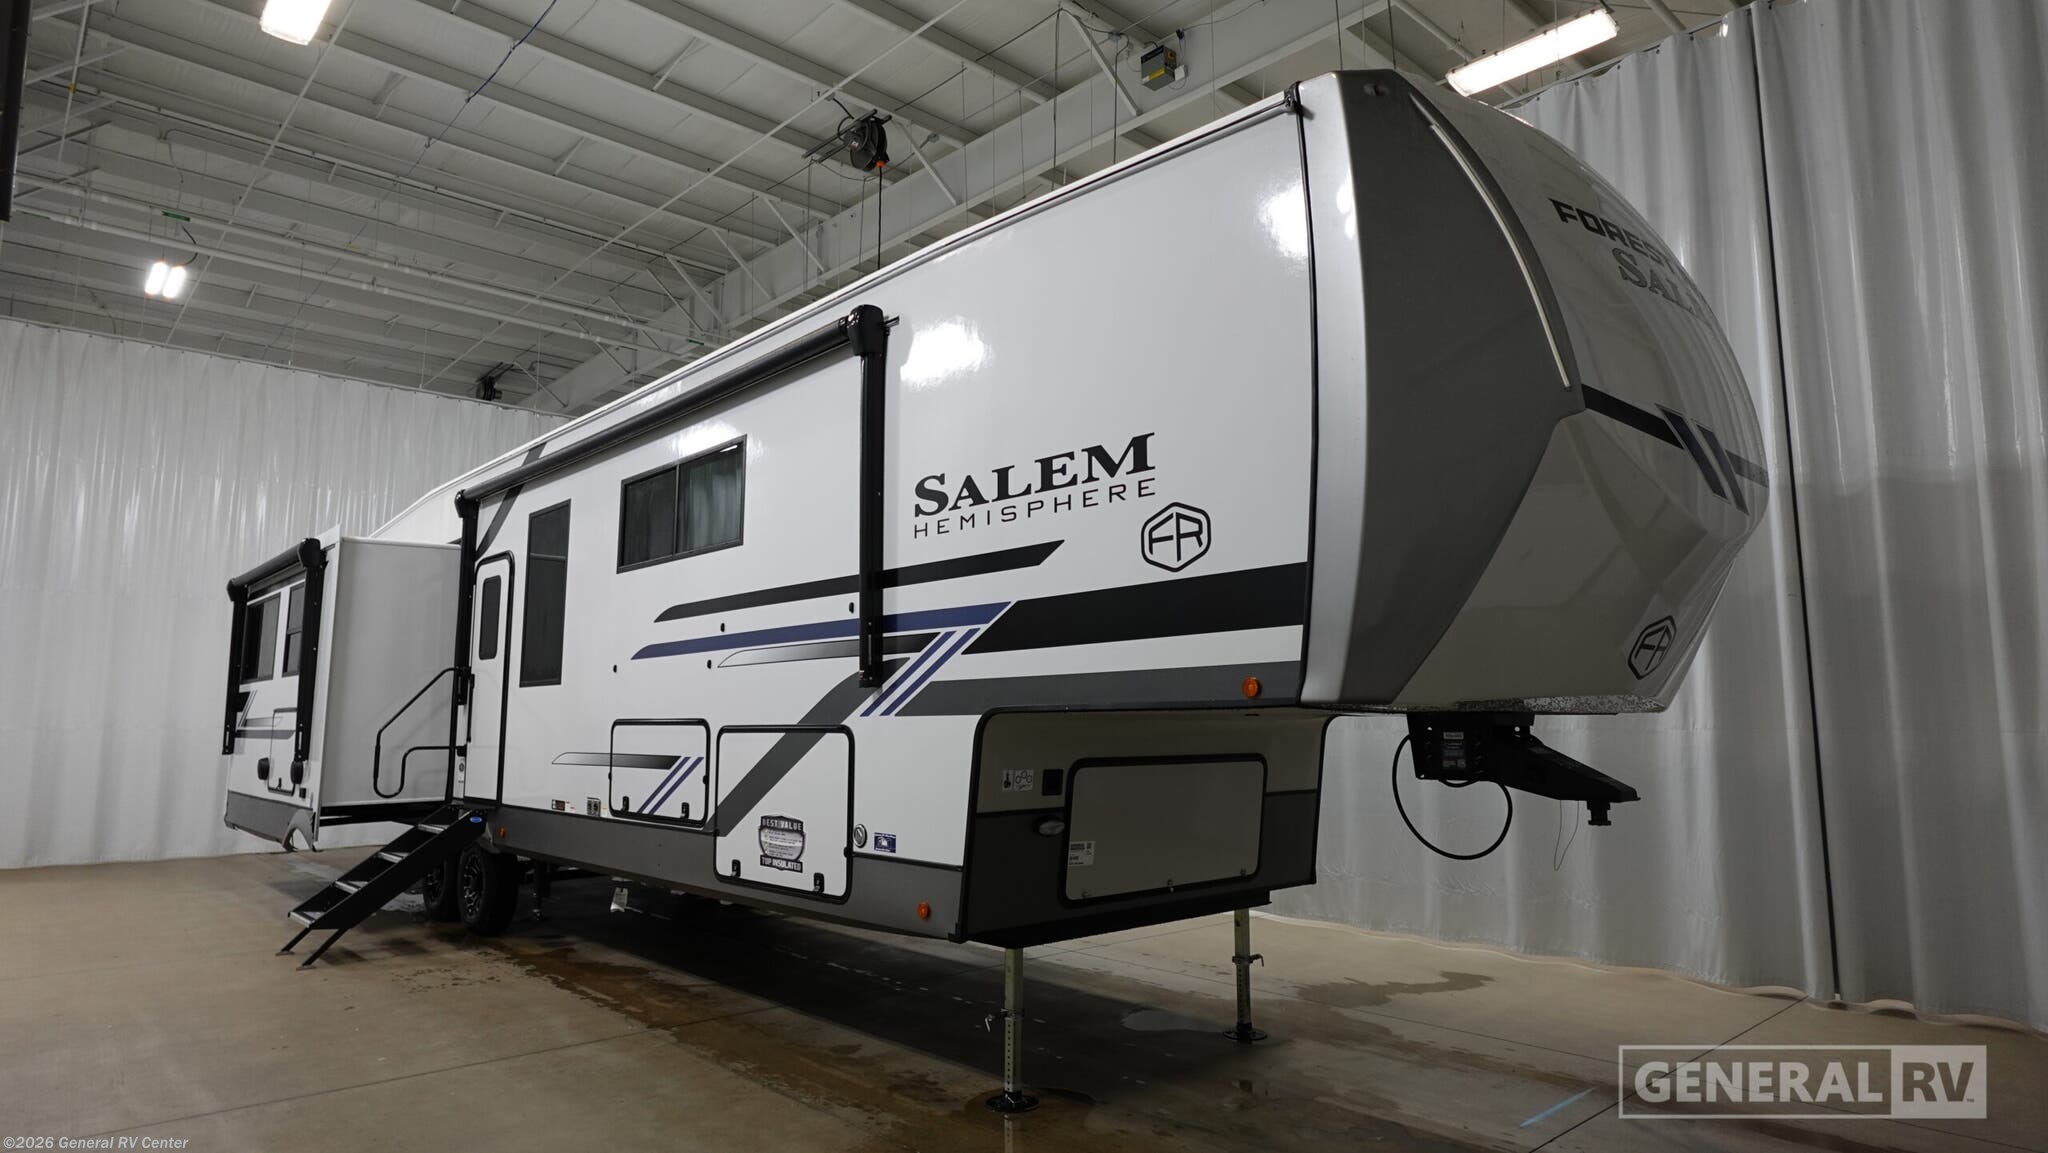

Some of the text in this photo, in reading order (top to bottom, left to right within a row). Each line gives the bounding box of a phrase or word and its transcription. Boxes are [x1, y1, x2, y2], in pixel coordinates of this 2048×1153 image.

[914, 431, 1156, 518] SALEM
[913, 477, 1156, 539] HEMISPHERE
[780, 820, 802, 831] VALUE
